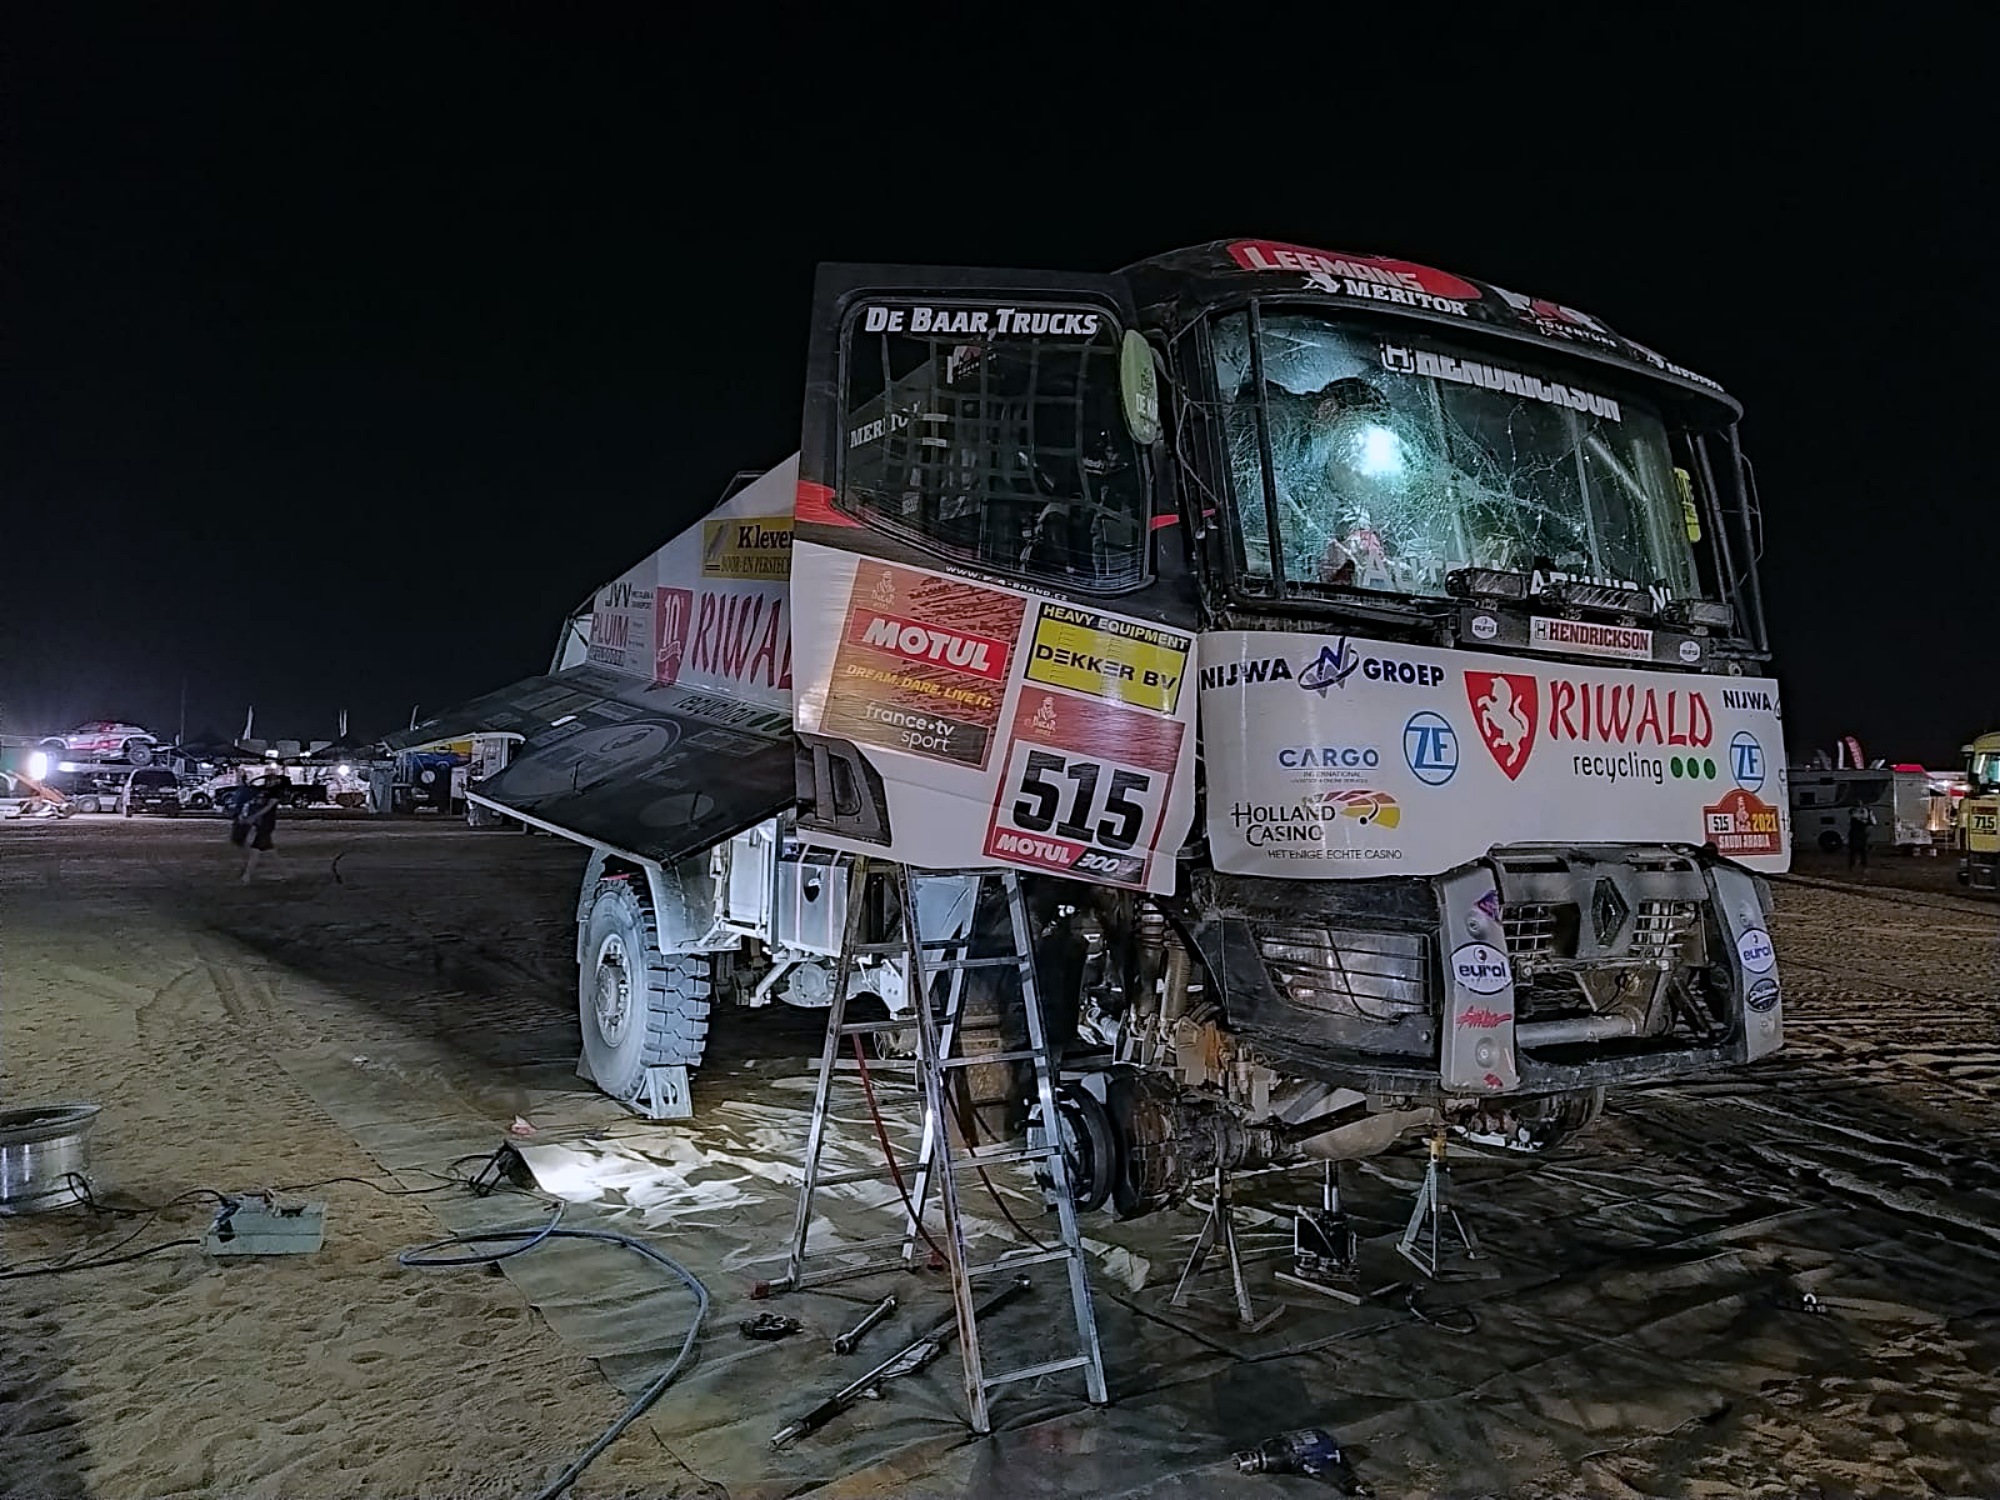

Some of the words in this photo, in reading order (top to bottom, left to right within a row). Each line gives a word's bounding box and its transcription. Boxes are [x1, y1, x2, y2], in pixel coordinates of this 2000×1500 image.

[1243, 246, 1426, 292] LEEMANS
[1344, 279, 1469, 317] MERITOR
[865, 307, 904, 332] DE
[910, 307, 989, 332] BAAR
[996, 308, 1099, 335] TRUCKS
[1043, 604, 1095, 626] HEAVY
[1098, 618, 1189, 650] EQUIPMENT
[1550, 621, 1649, 651] HENDRICKSON
[862, 618, 990, 672] MOTUL
[1036, 644, 1136, 681] DEKKER
[1143, 671, 1178, 691] BV
[1200, 658, 1293, 691] NIJWA
[1363, 658, 1445, 687] GROEP
[944, 688, 976, 702] LIVE
[1722, 690, 1773, 711] NIJWA
[1548, 679, 1714, 749] RIWALD
[900, 730, 951, 752] sport
[1406, 726, 1458, 770] ZF
[1278, 748, 1380, 768] CARGO
[1573, 752, 1664, 785] recycling
[1730, 743, 1764, 781] ZF
[1012, 750, 1151, 851] 515
[1231, 802, 1336, 828] HOLLAND
[1246, 824, 1324, 847] CASINO
[1713, 816, 1730, 832] 515
[1751, 813, 1778, 833] 2021
[1974, 815, 1995, 829] 715
[996, 833, 1071, 864] MOTUL
[1326, 850, 1362, 860] ECHTE
[1364, 850, 1402, 860] CASINO
[1458, 962, 1507, 978] eurol
